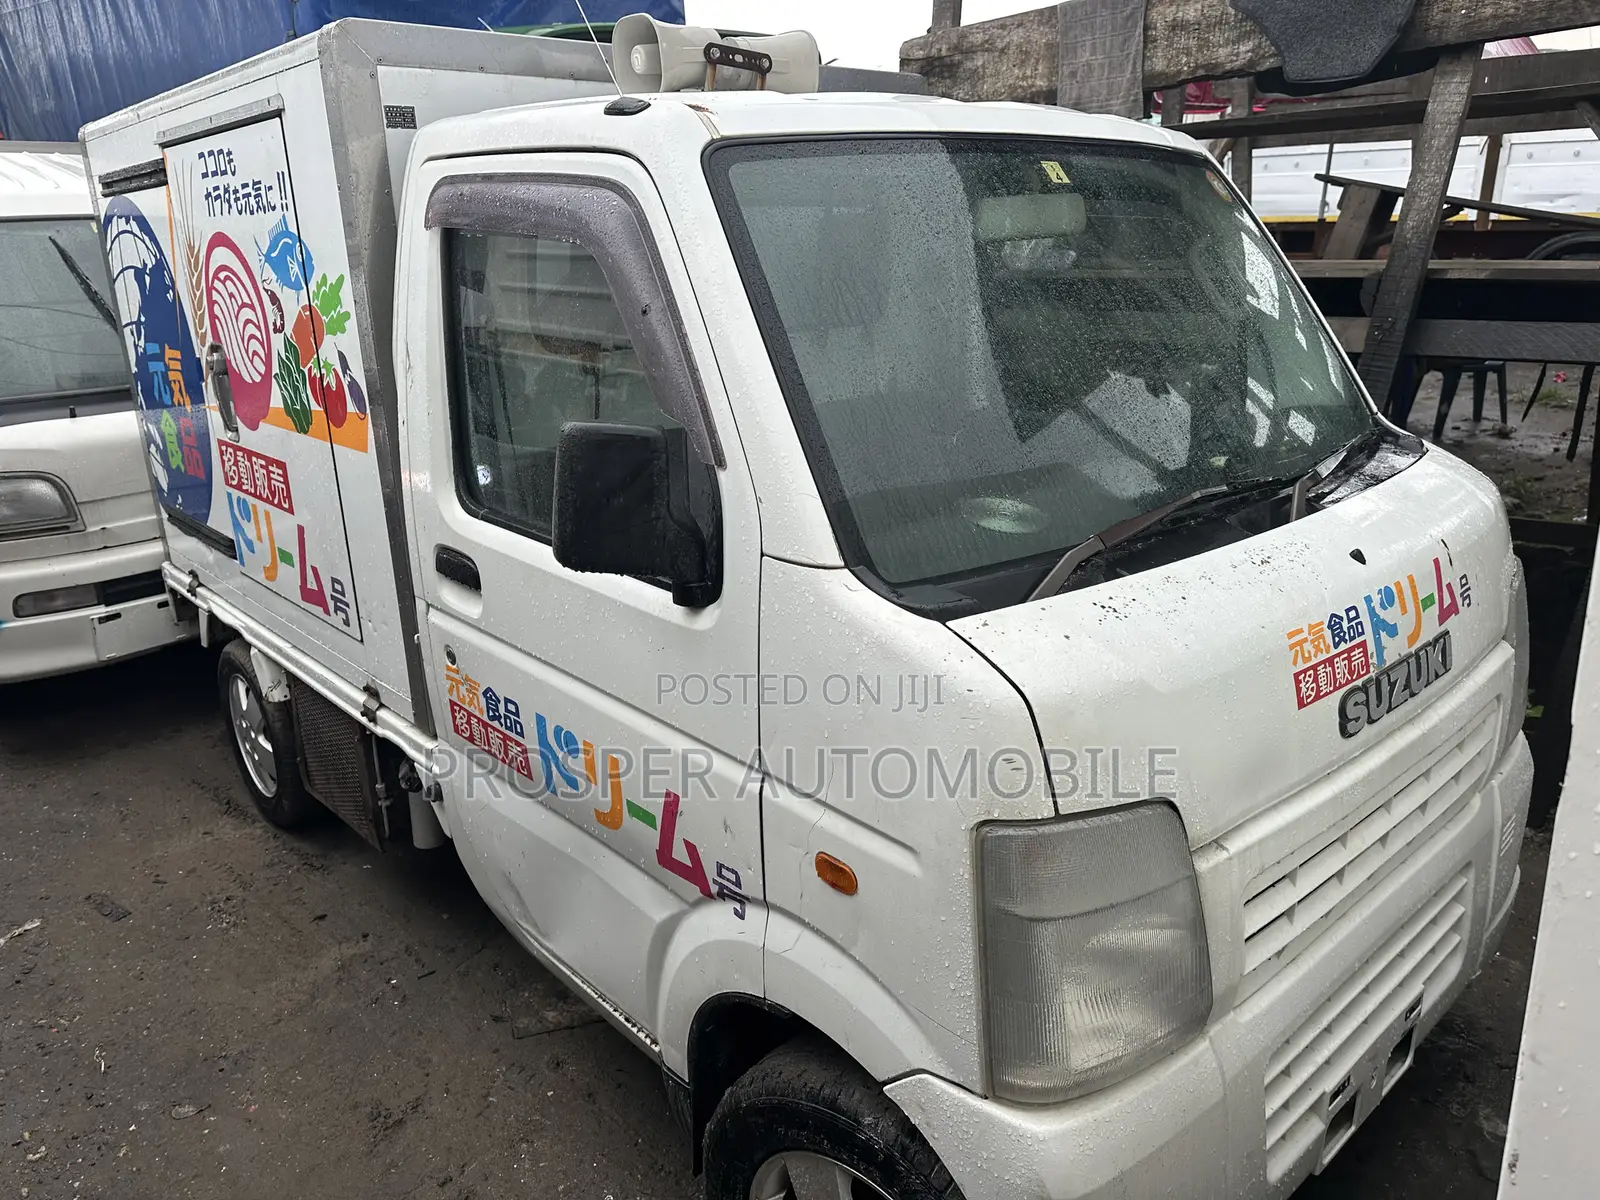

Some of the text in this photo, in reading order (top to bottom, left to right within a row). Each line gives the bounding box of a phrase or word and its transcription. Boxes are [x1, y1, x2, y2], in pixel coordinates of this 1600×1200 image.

[197, 148, 237, 180] ココロも
[221, 444, 290, 509] 移動販売
[1287, 605, 1366, 668] 元気食品
[445, 664, 525, 740] 元気食品
[1298, 647, 1368, 705] 移動販売
[1338, 628, 1452, 740] SUZUKI
[453, 705, 529, 777] 移動販売
